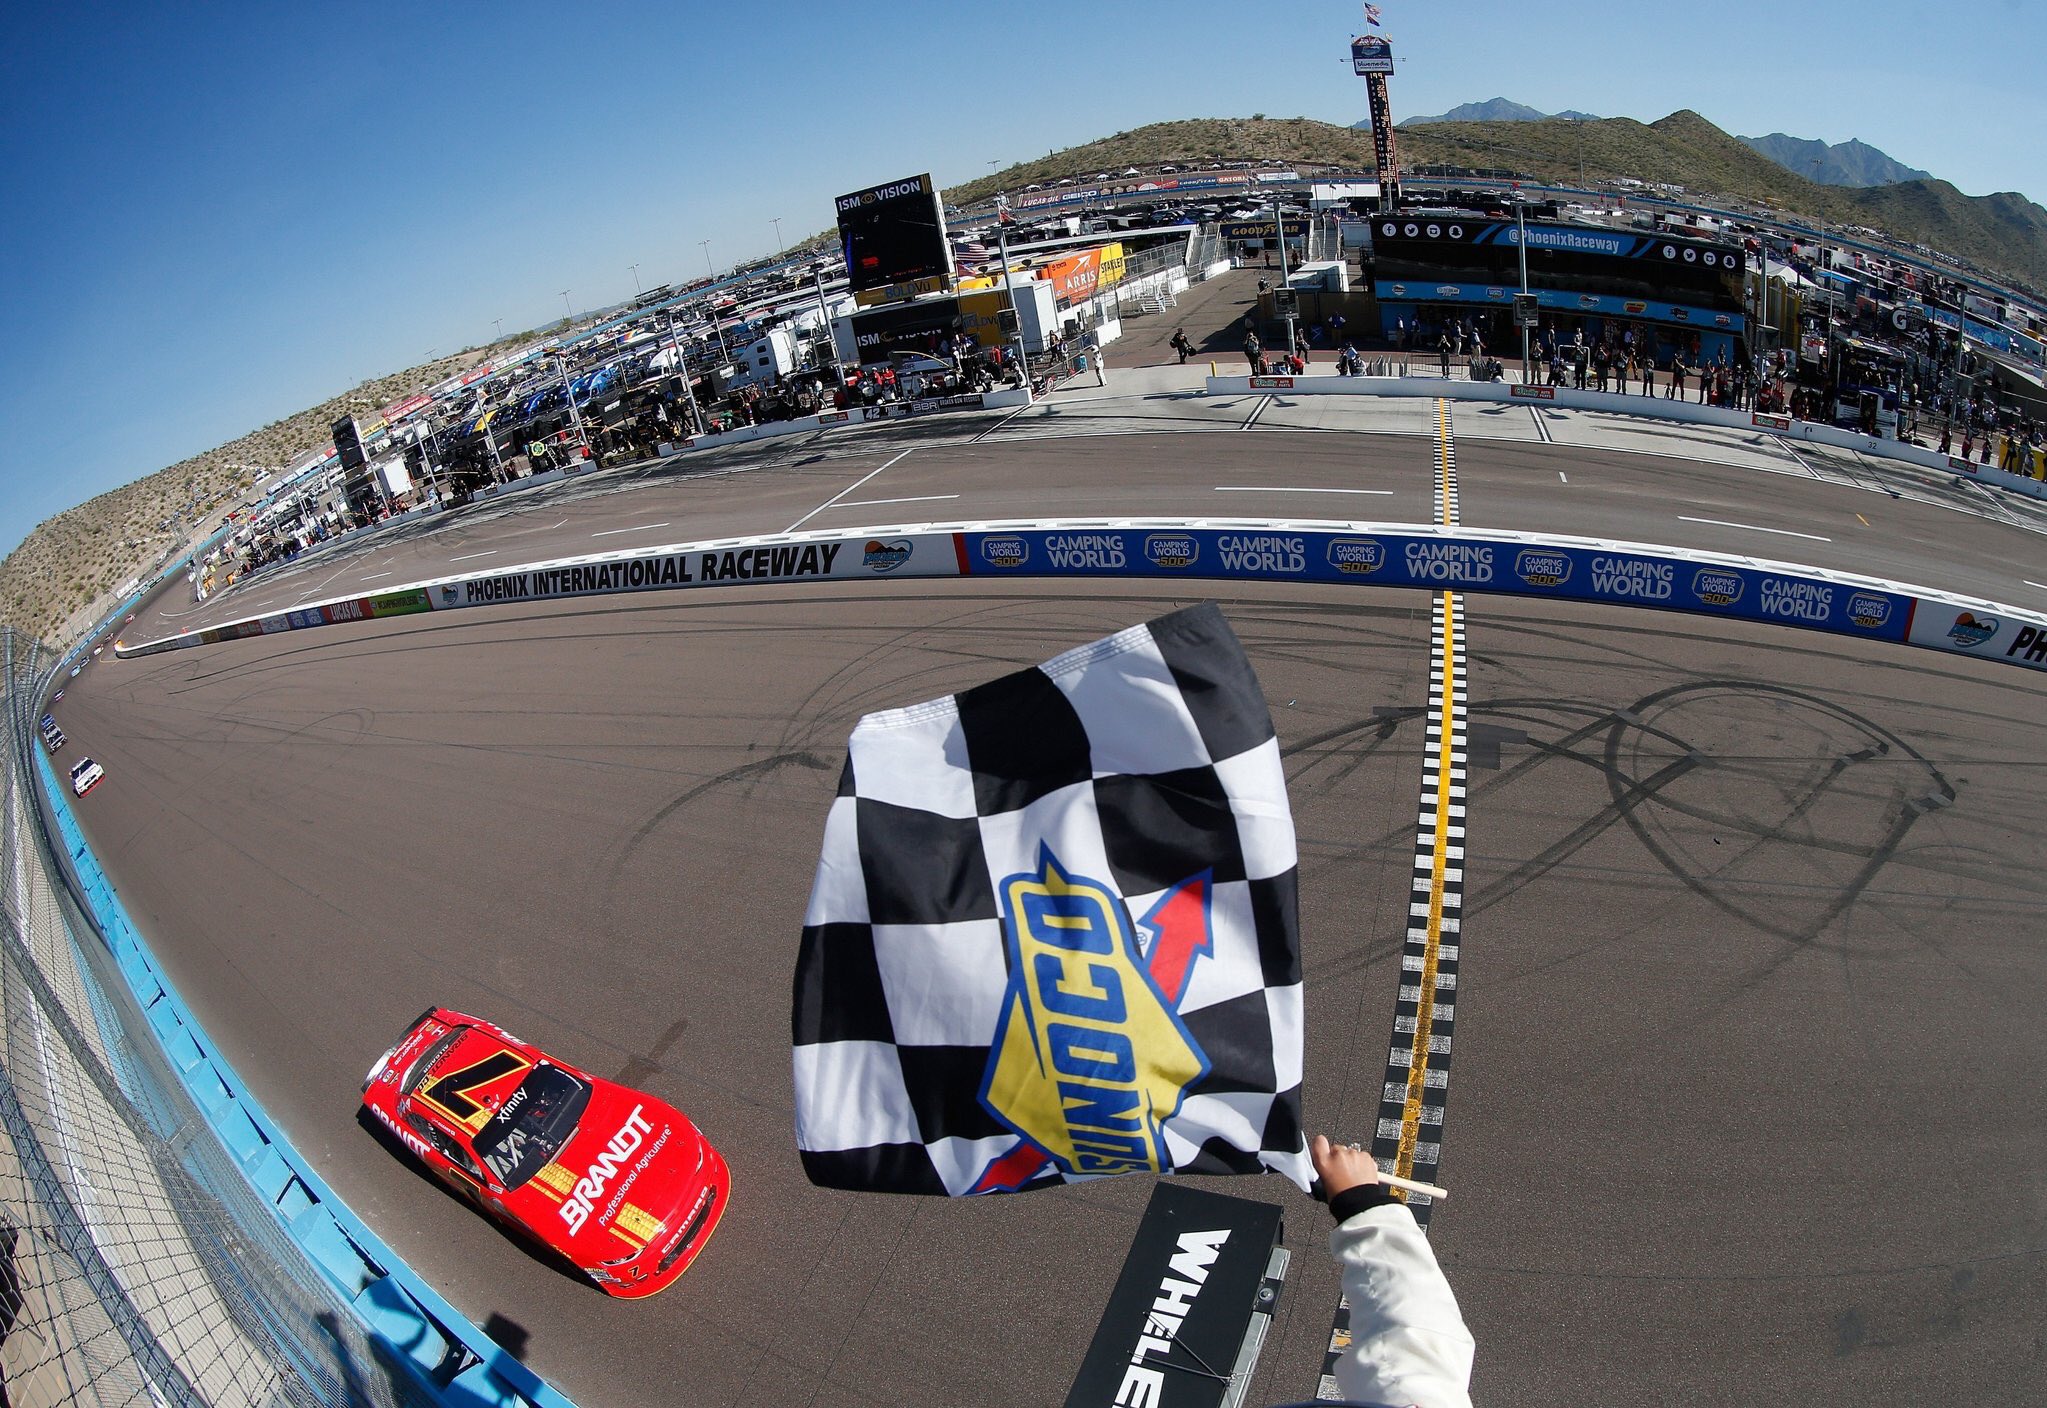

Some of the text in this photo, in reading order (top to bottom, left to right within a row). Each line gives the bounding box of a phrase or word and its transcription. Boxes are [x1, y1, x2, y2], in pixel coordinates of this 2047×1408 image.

[839, 180, 920, 211] ISM VISION
[1062, 190, 1096, 200] GEICO
[1023, 198, 1046, 207] LUCAS
[1232, 224, 1299, 235] GOODYAR
[1508, 228, 1619, 252] @PhoenixRaceway
[1067, 270, 1096, 289] ARRIS
[1893, 310, 1907, 329] G
[857, 333, 880, 347] ISM
[1868, 361, 1877, 370] 3
[865, 408, 880, 419] 42
[913, 402, 938, 412] BBR
[988, 541, 1020, 550] CAMPING
[1045, 535, 1124, 550] CAMPING
[1153, 540, 1189, 550] CAMPING
[1217, 536, 1305, 554] CAMPING
[989, 548, 1021, 556] WORLD
[1153, 548, 1190, 556] WORLD
[1336, 545, 1375, 555] CAMPING
[1405, 543, 1493, 564] CAMPING
[995, 557, 1019, 565] 500
[1047, 550, 1126, 568] WORLD
[1160, 557, 1186, 566] 500
[1219, 551, 1306, 572] WORLD
[1337, 552, 1375, 562] WORLD
[1525, 556, 1563, 568] CAMPING
[466, 543, 842, 602] PHOENIX INTERNATIONAL RACEWAY
[1342, 562, 1370, 572] 500
[1406, 558, 1493, 582] WORLD
[1525, 564, 1563, 575] WORLD
[1591, 557, 1674, 581] CAMPING
[1529, 575, 1557, 586] 500
[1592, 572, 1672, 599] WORLD
[1702, 575, 1736, 587] CAMPING
[1702, 582, 1735, 595] WORLD
[1760, 578, 1833, 602] CAMPING
[1704, 593, 1730, 604] 500
[1855, 599, 1885, 611] CAMPING
[329, 600, 363, 621] LUCAS OIL
[1761, 593, 1830, 621] WORLD
[1855, 605, 1883, 618] WORLD
[1856, 616, 1878, 628] 500
[1021, 892, 1152, 1173] SUNOCO
[424, 1044, 449, 1073] ALLGAIER
[421, 1048, 532, 1124] 7
[497, 1087, 528, 1124] xfinity
[559, 1104, 652, 1237] BRANDT
[599, 1170, 638, 1226] Professional
[636, 1126, 672, 1172] Agriculture
[662, 1186, 708, 1254] CAMARO
[629, 1266, 640, 1278] 7
[1112, 1230, 1232, 1408] WHELE
